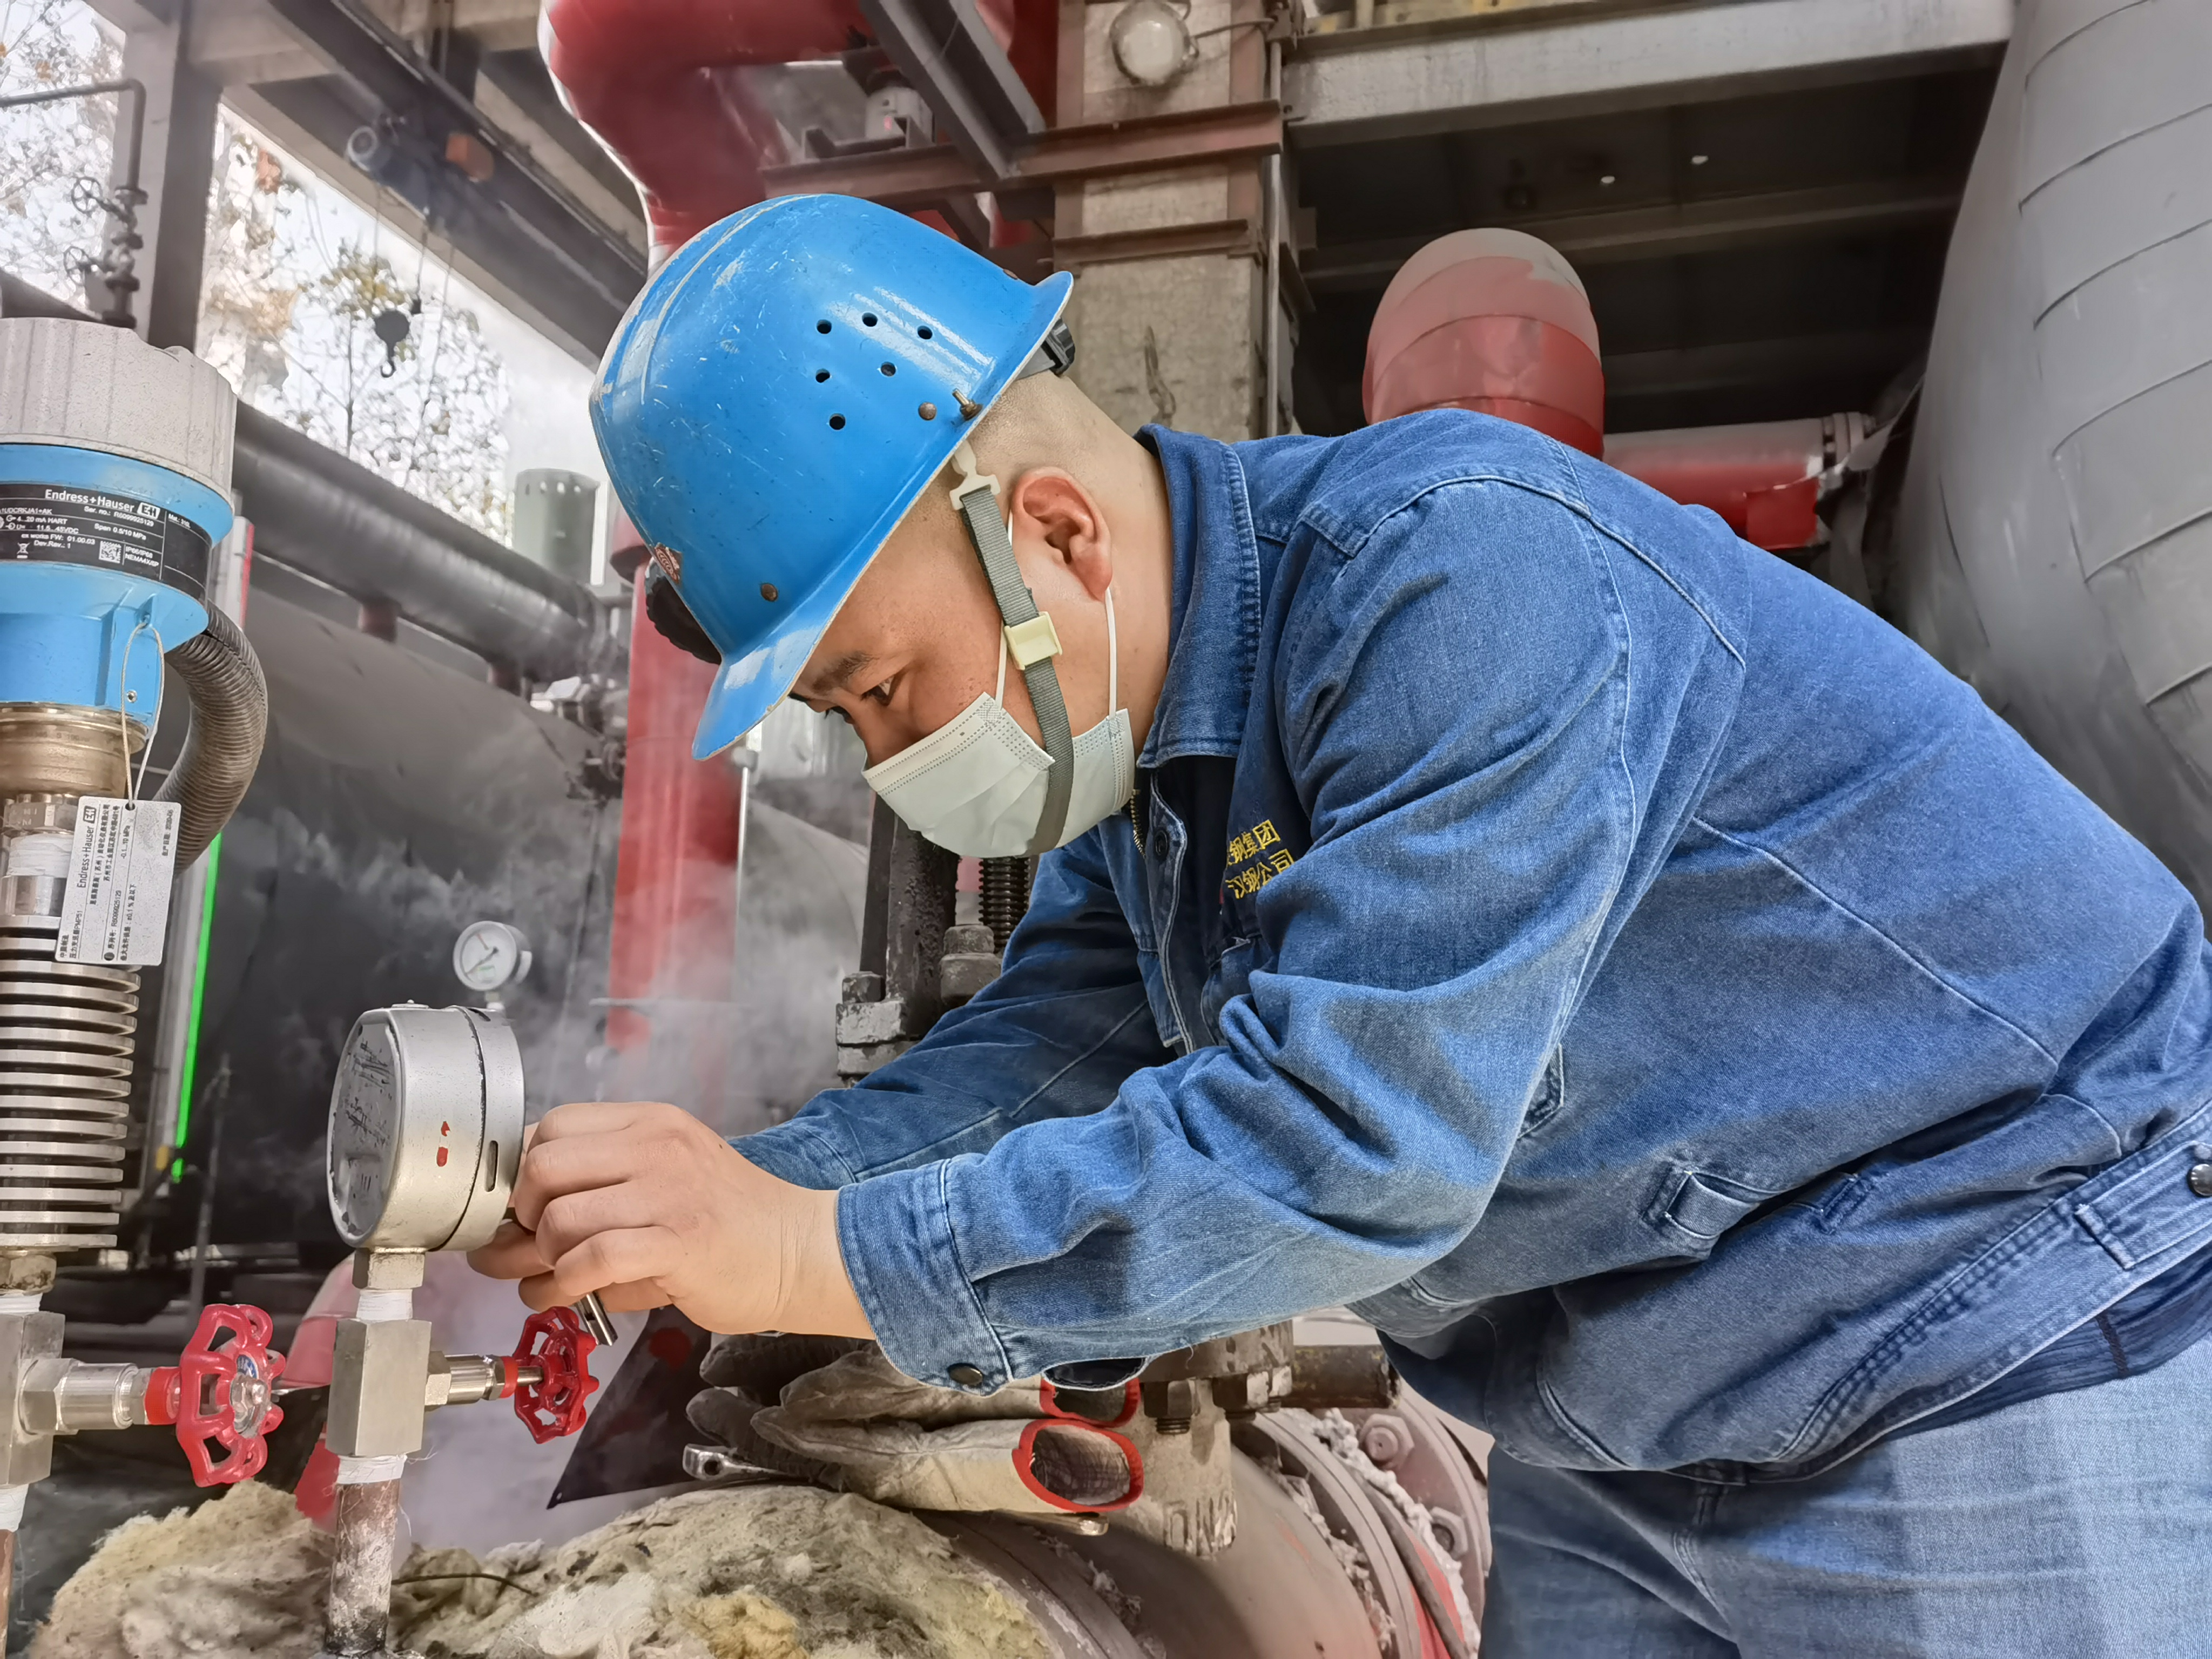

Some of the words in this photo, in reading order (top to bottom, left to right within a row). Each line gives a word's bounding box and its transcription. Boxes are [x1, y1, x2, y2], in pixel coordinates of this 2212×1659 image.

[45, 489, 134, 512] Endress+Hauser
[48, 517, 68, 525] HART
[94, 523, 111, 531] Span
[132, 532, 147, 541] MPa
[1228, 819, 1281, 865] 钢集团
[77, 826, 94, 888] Endress+Hauser
